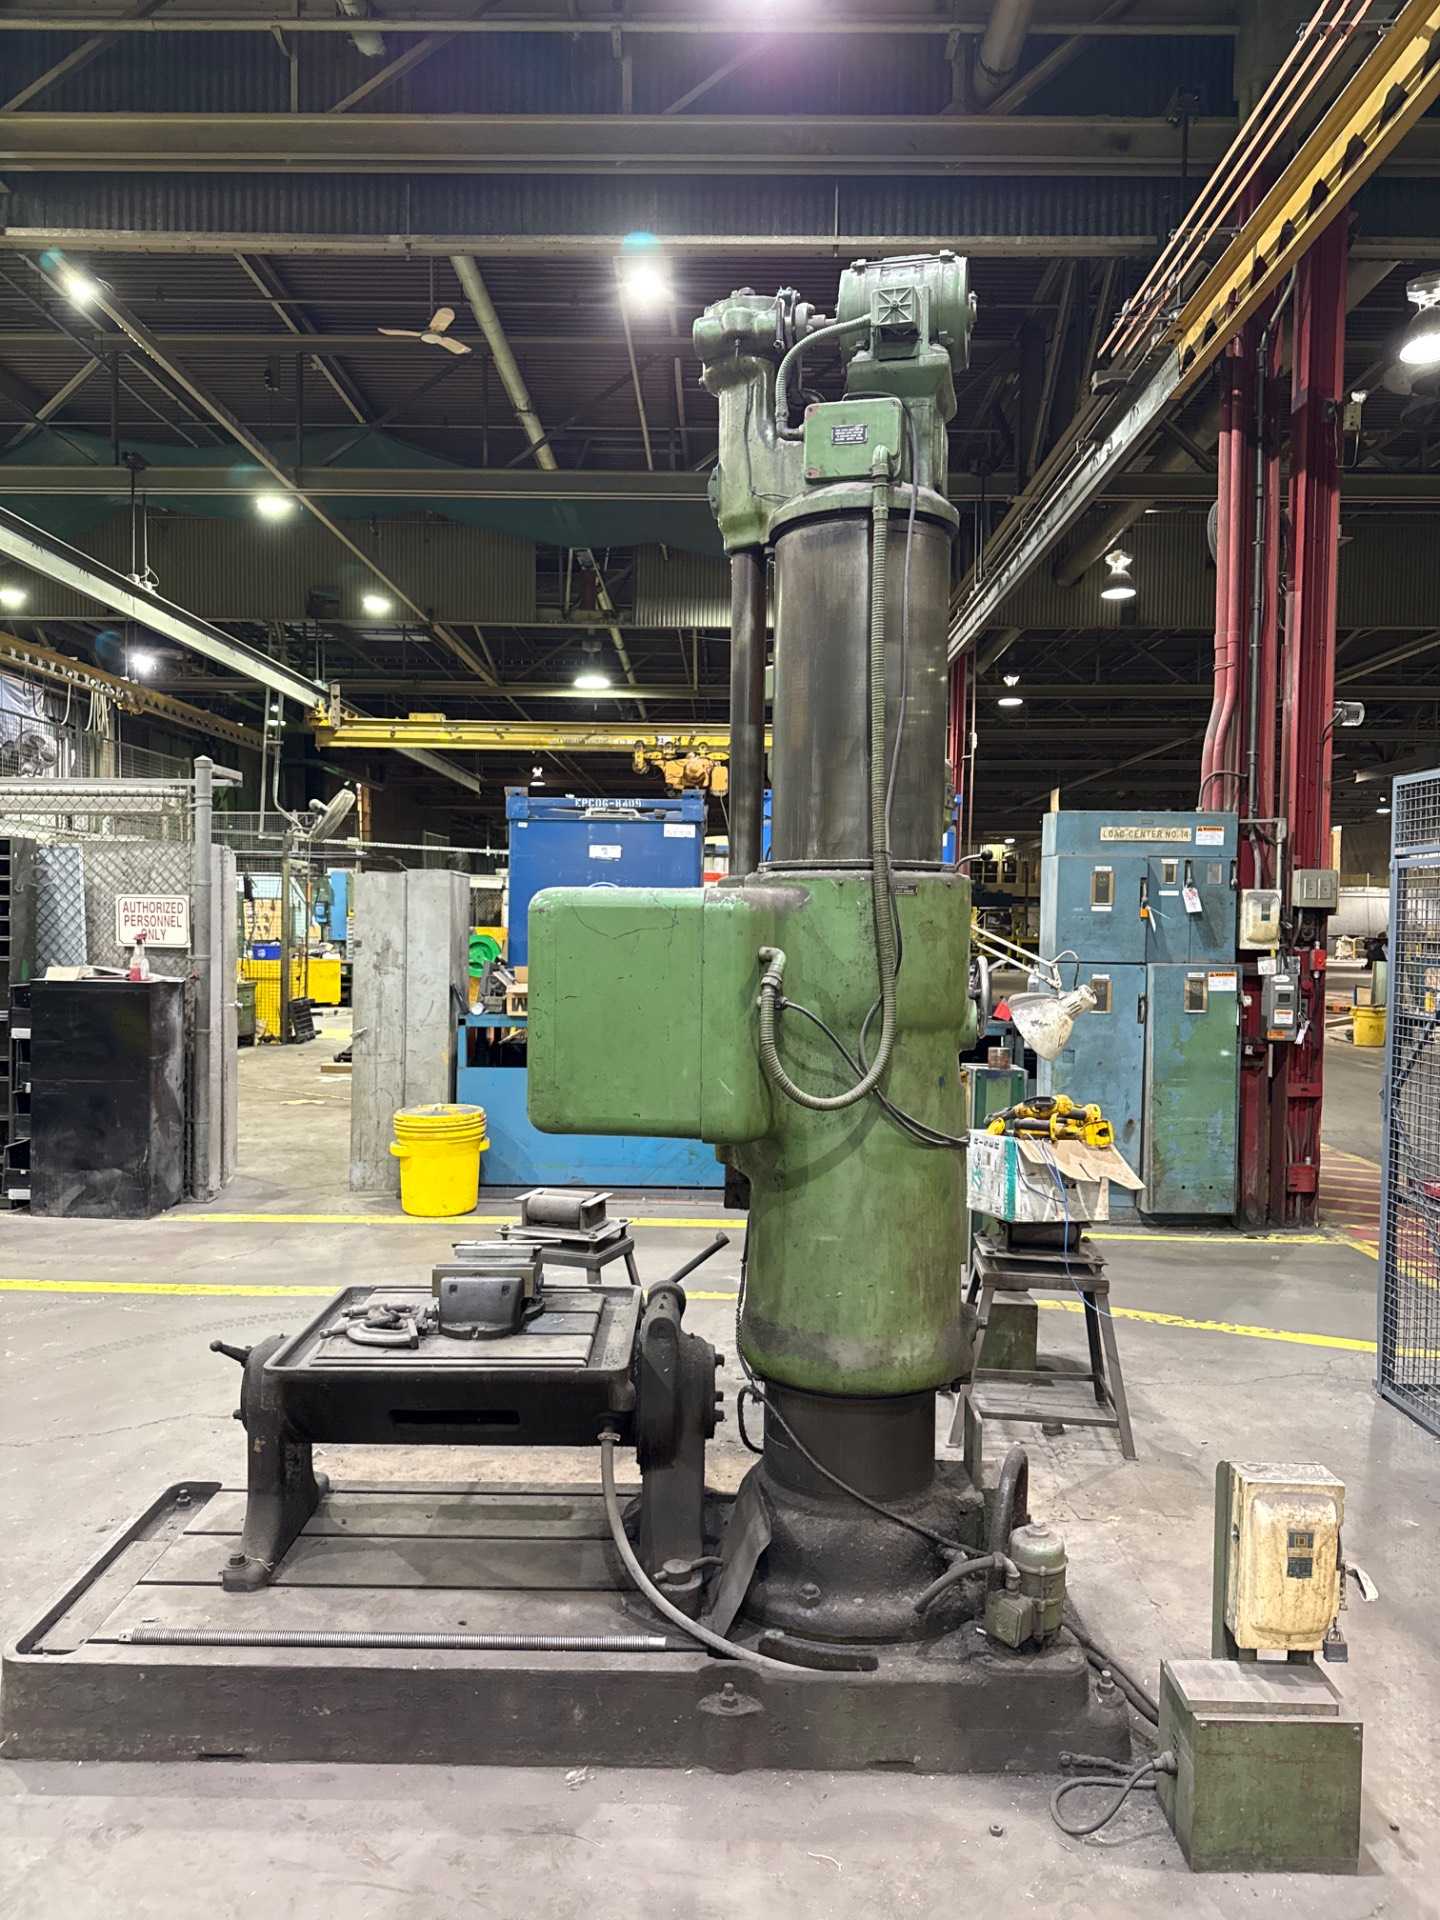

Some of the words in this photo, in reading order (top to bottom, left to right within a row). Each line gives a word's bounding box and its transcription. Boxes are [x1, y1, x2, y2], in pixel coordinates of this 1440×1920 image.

[1129, 830, 1163, 839] CENTER
[122, 901, 184, 914] AUTHORIZED
[124, 914, 182, 928] PERSONNEL
[141, 928, 166, 941] ONLY
